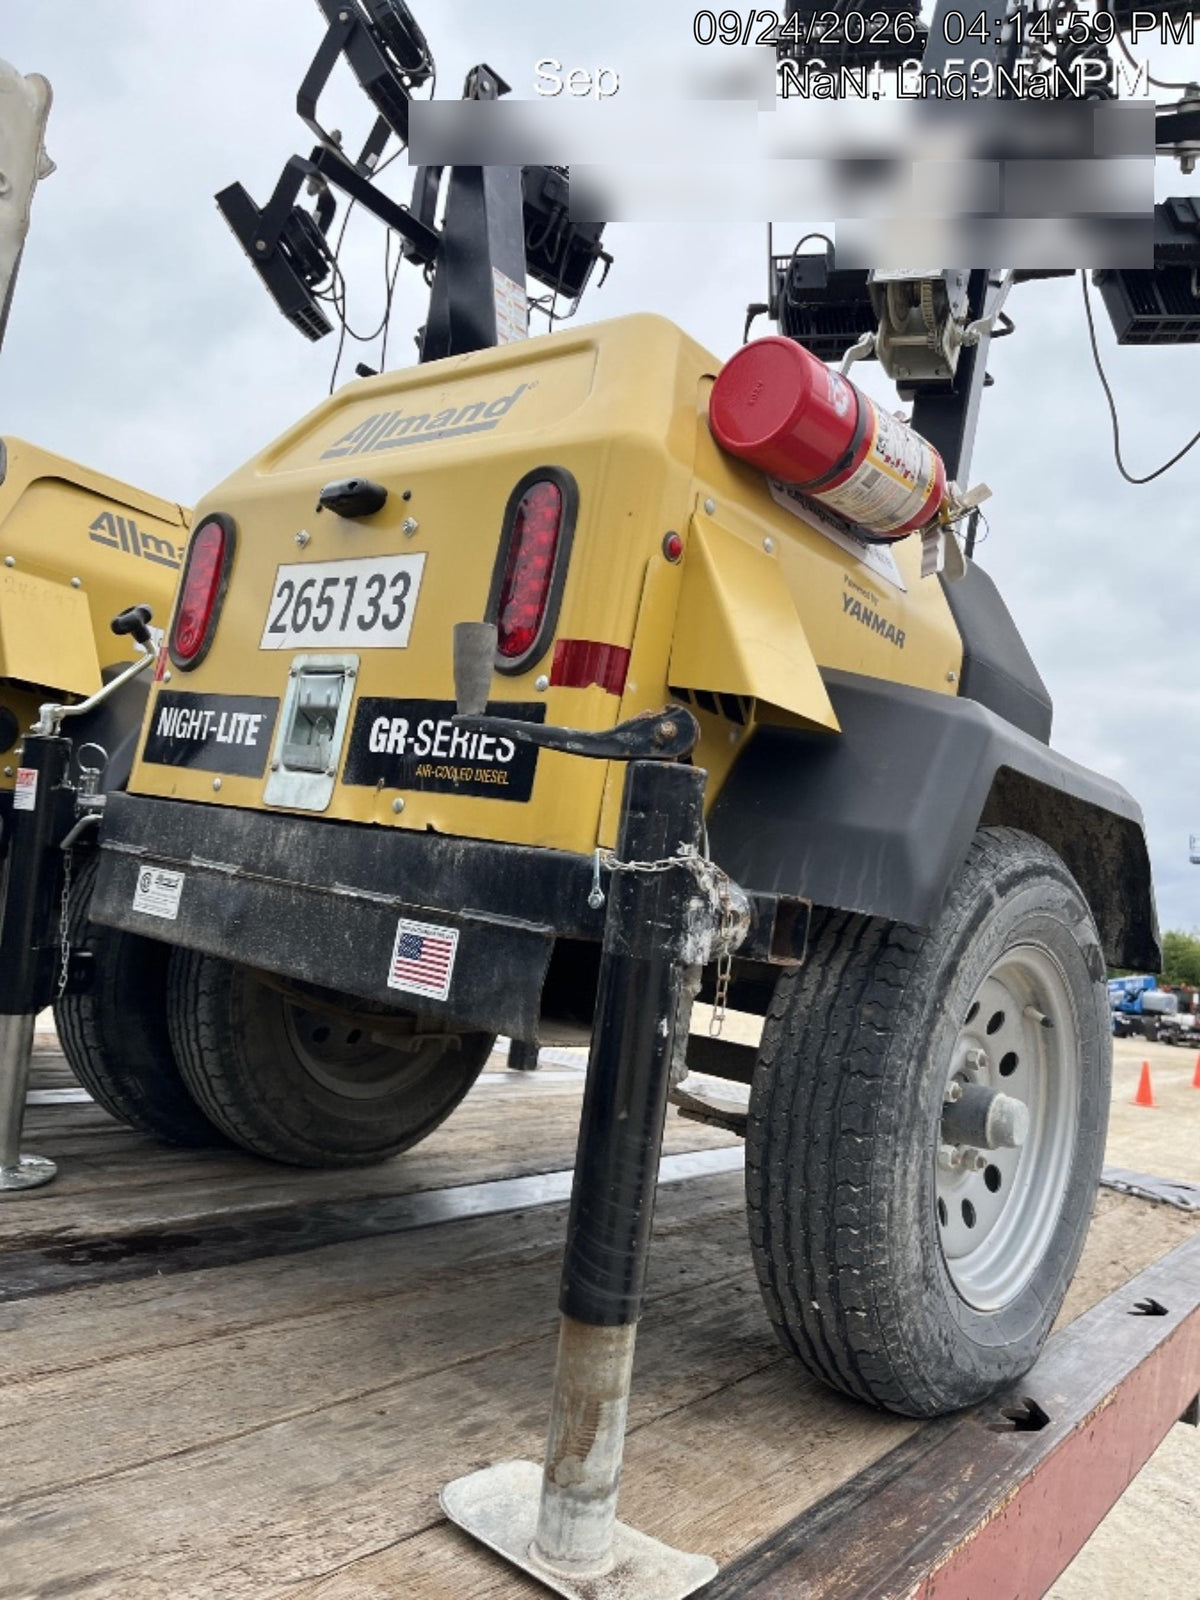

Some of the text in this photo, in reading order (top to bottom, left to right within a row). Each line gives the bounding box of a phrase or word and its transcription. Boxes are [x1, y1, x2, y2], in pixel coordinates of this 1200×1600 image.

[320, 383, 529, 460] Allmand
[267, 570, 412, 634] 265133
[842, 592, 906, 650] YANMAR
[156, 707, 263, 746] NIGHT-LITE
[368, 716, 517, 763] GR-SERIES
[415, 763, 510, 785] AIR-COOLED DIESEL
